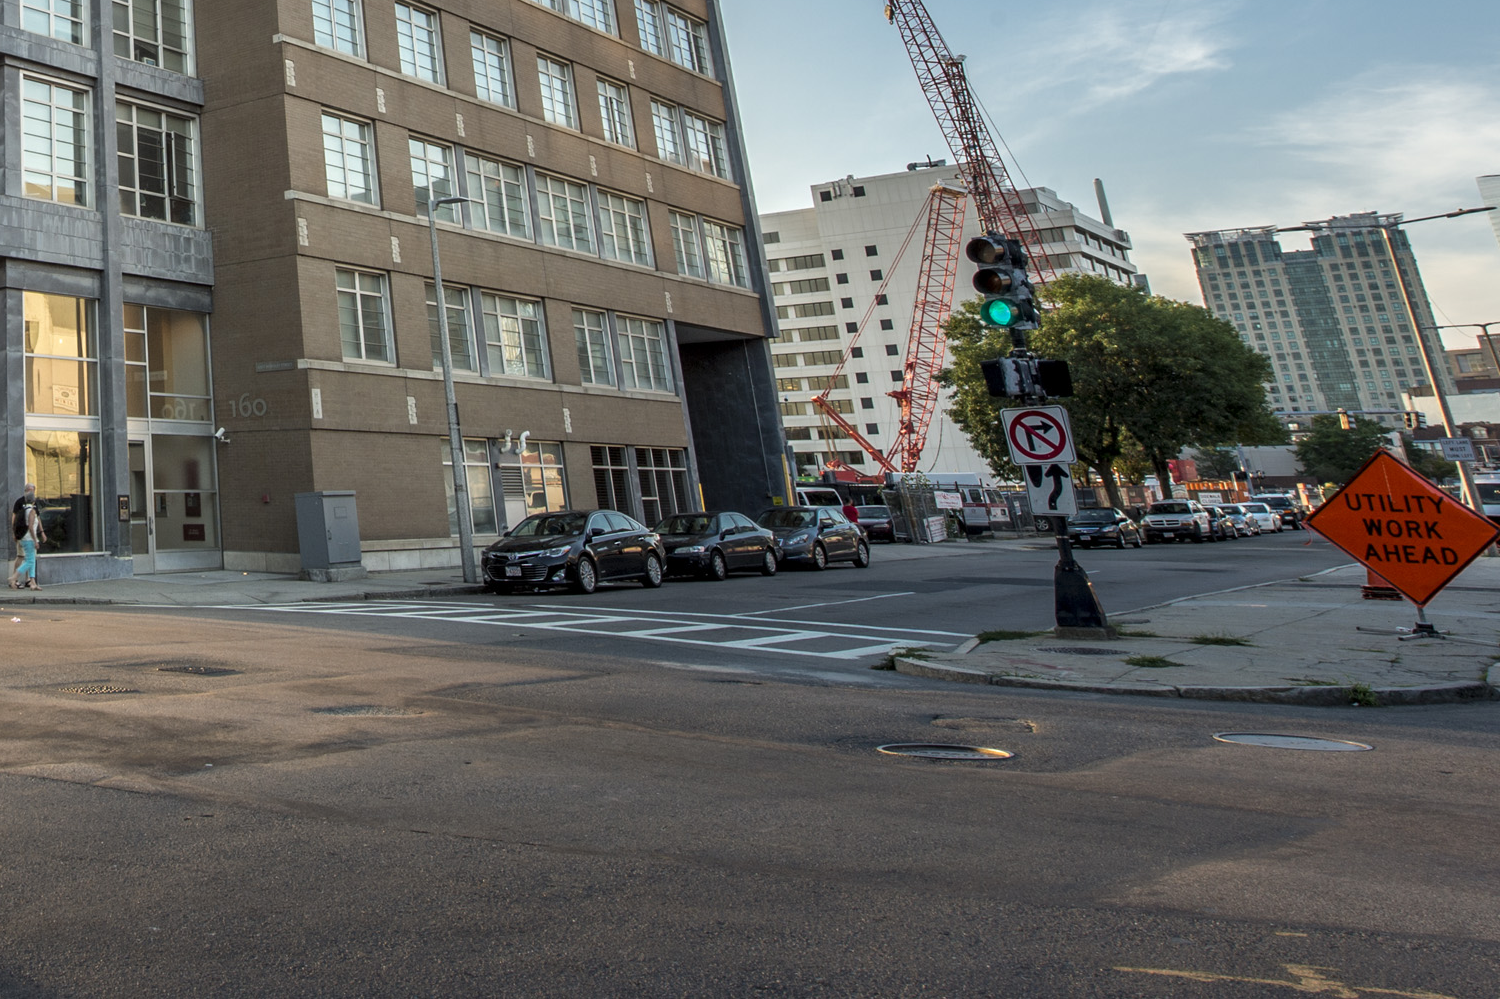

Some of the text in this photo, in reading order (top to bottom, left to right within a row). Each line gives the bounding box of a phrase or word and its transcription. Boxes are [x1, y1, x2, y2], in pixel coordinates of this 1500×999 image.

[229, 393, 267, 417] 160
[1344, 493, 1444, 514] UTILITY
[1362, 518, 1444, 540] WORK
[1364, 543, 1459, 565] AHEAD
